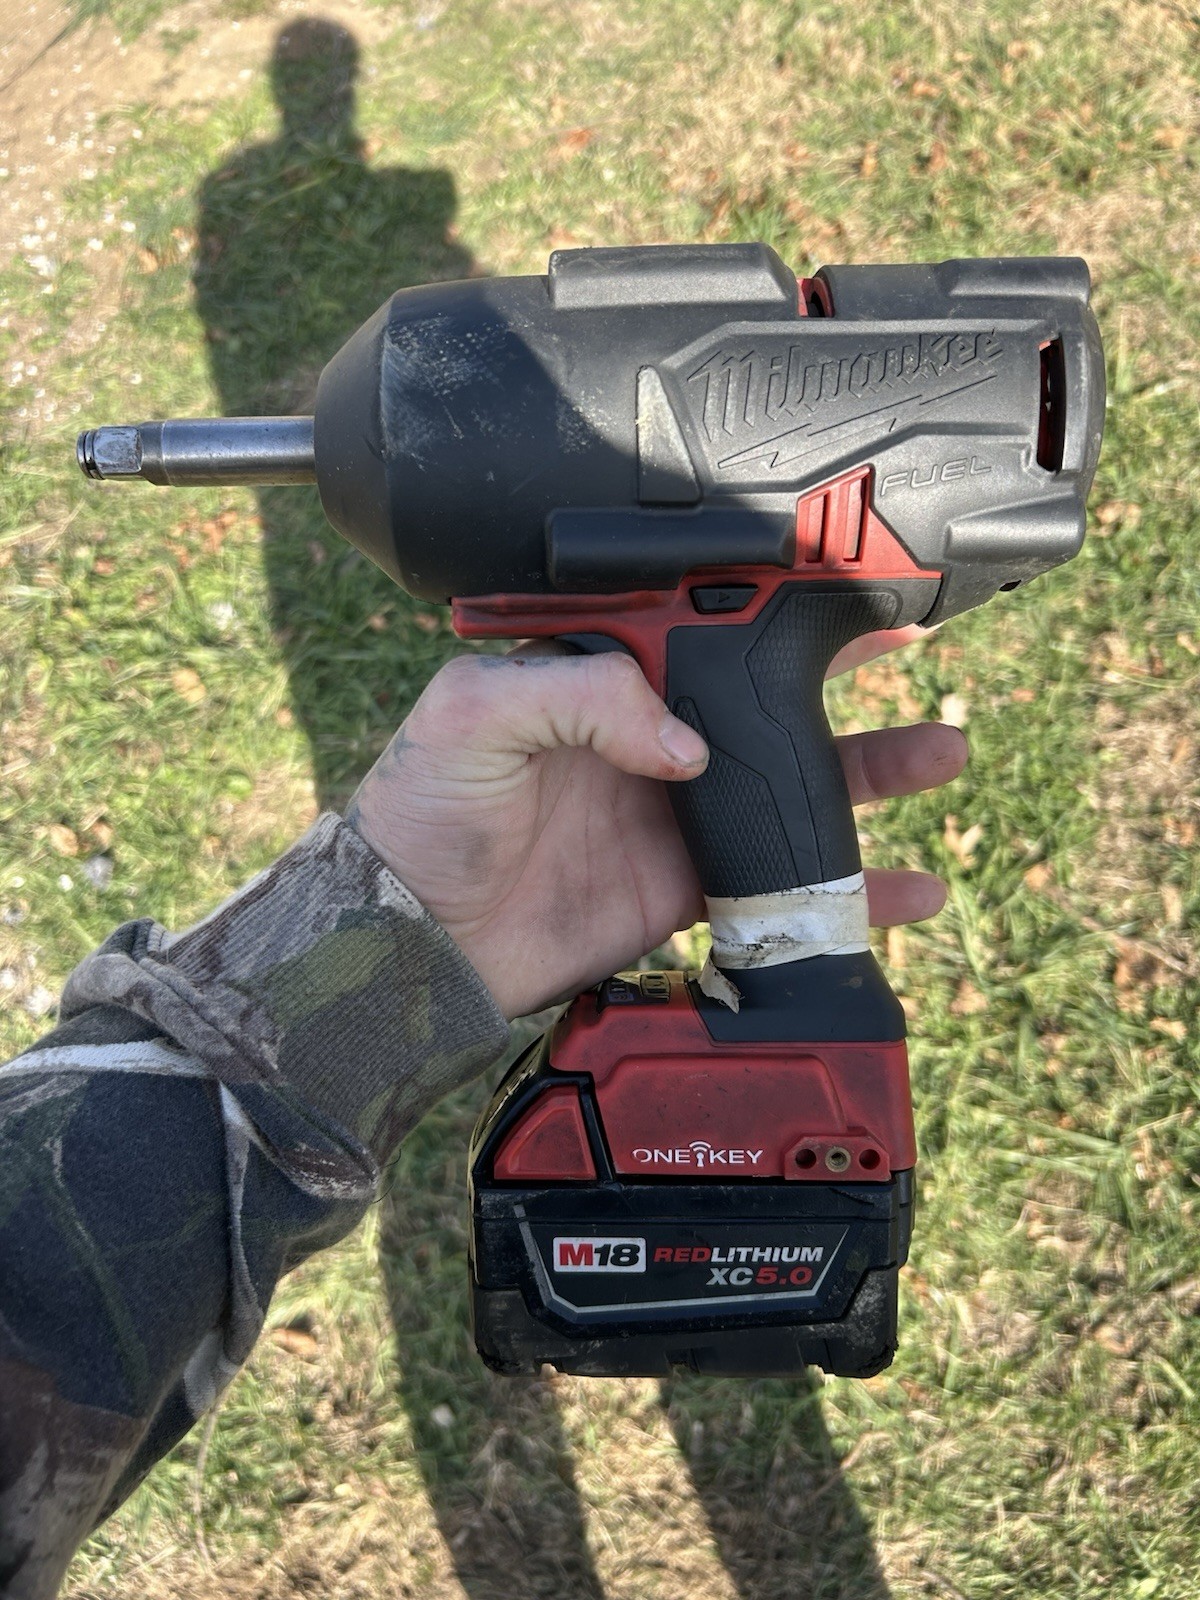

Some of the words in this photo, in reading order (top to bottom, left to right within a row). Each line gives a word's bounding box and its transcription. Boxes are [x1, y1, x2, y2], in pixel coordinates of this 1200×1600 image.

[687, 328, 1003, 442] Milwaukee
[880, 455, 992, 497] FUEL
[558, 1243, 641, 1267] M18
[653, 1246, 824, 1263] REDLITHIUM
